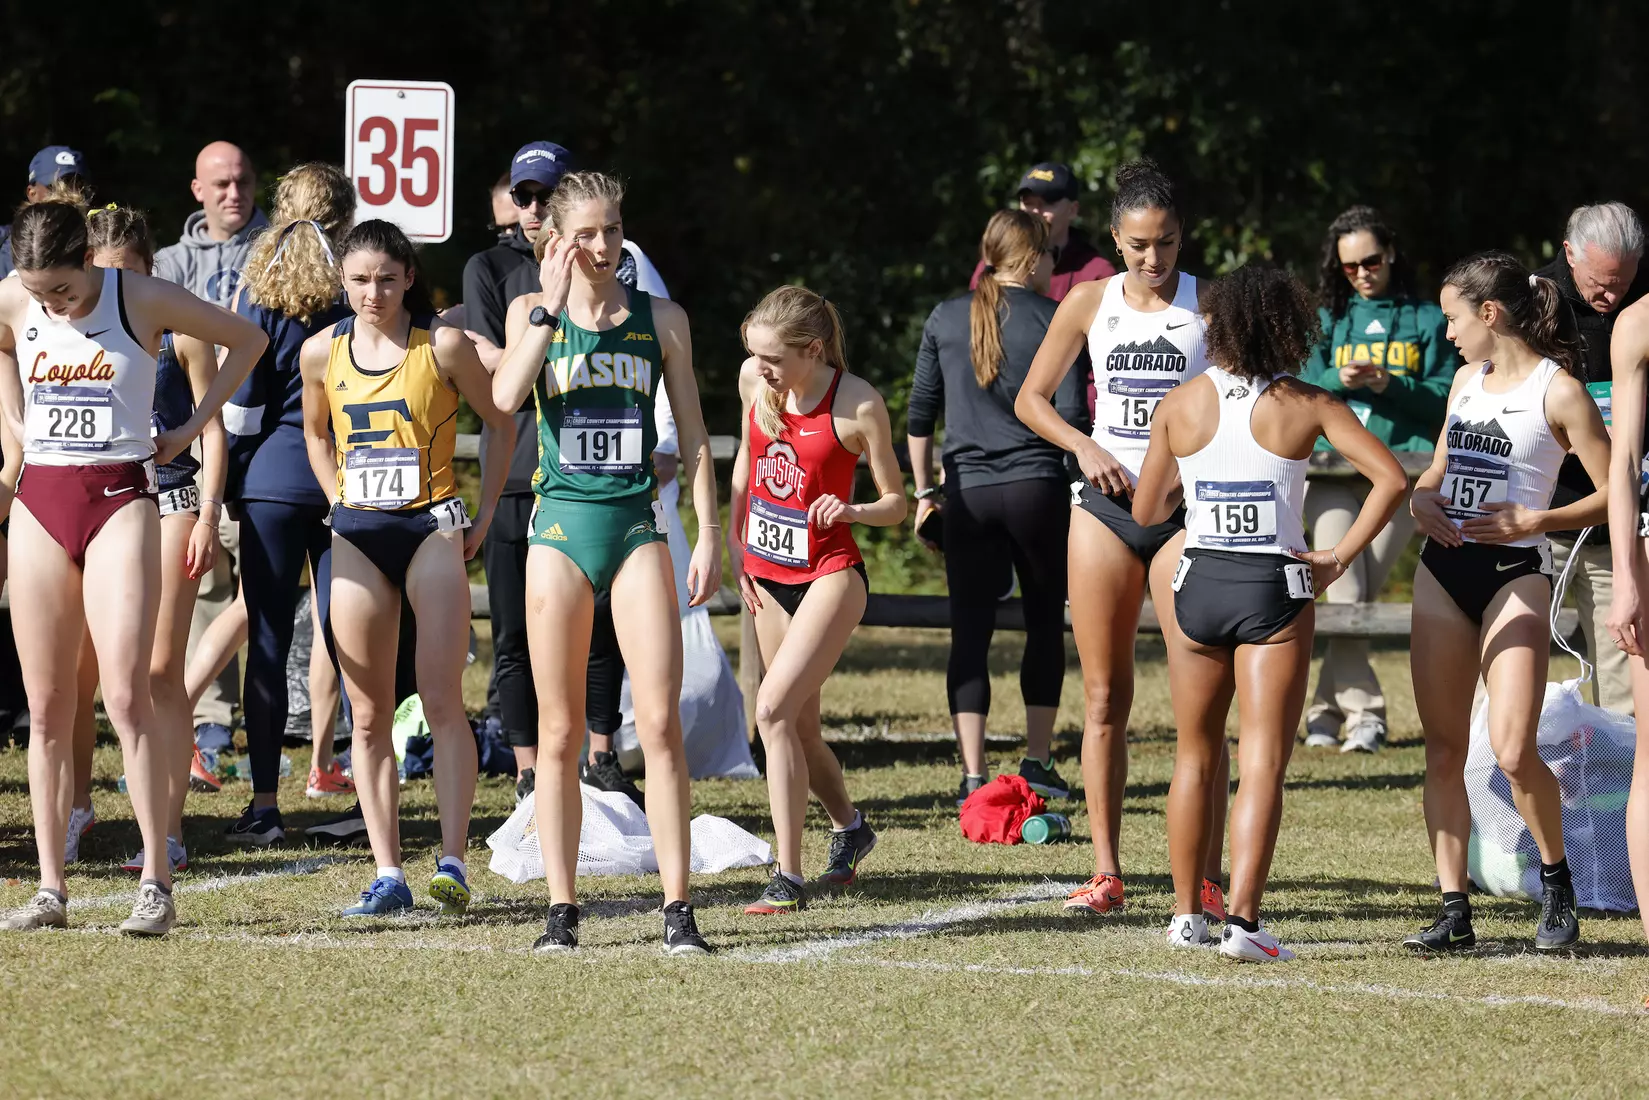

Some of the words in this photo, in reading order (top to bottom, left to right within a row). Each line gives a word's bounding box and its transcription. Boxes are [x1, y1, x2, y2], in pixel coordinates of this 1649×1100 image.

[357, 116, 440, 207] 35
[28, 350, 114, 386] Loyola
[544, 352, 652, 400] MASON
[1106, 353, 1187, 373] COLORADO
[49, 407, 96, 439] 228
[576, 430, 622, 461] 191
[1447, 431, 1513, 458] COLORADO
[359, 468, 404, 498] 174
[755, 457, 777, 487] OHIO
[777, 456, 806, 502] STATE
[1450, 477, 1492, 509] 157
[167, 487, 197, 511] 195
[1210, 504, 1259, 534] 159
[540, 532, 568, 541] adidas
[757, 519, 795, 555] 334
